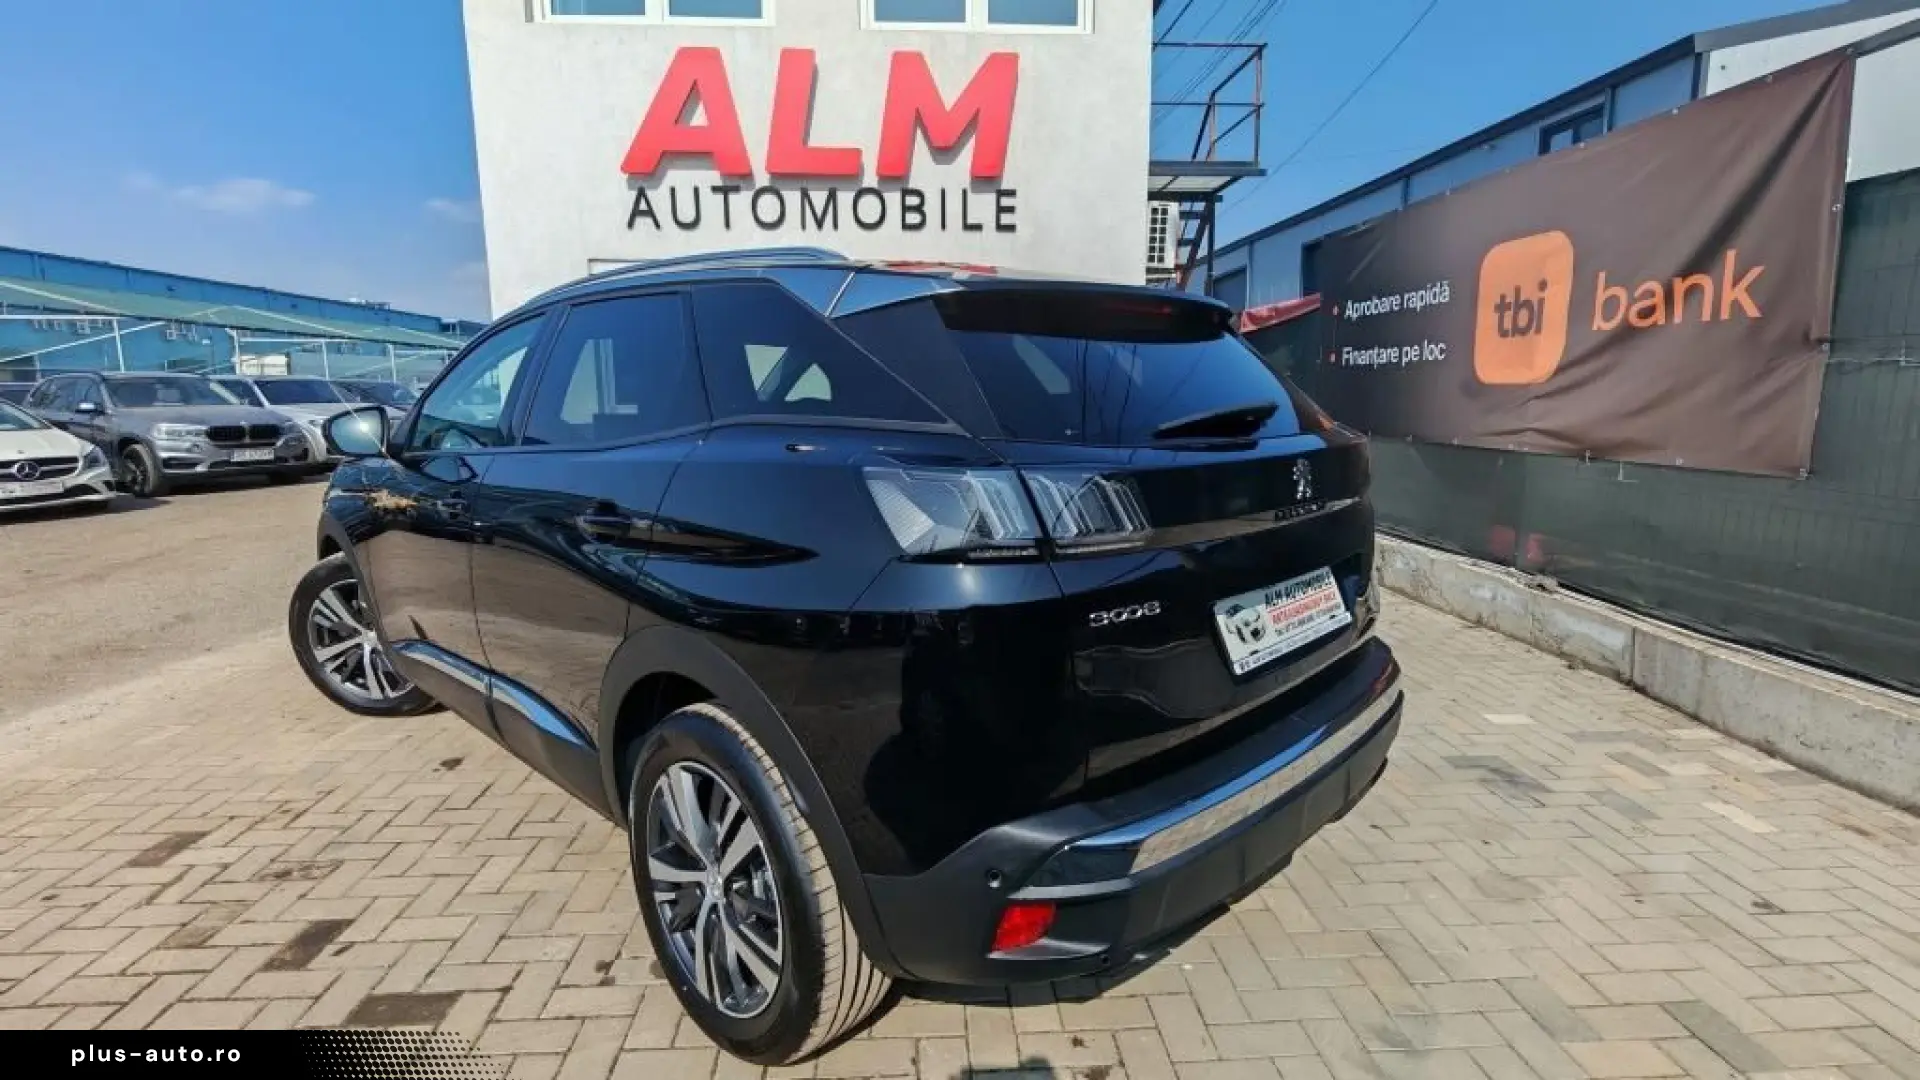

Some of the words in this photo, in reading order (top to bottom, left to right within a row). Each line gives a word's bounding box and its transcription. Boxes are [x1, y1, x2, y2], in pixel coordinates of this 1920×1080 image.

[621, 46, 1020, 178] ALM
[627, 185, 1018, 232] AUTOMOBILE
[1343, 294, 1401, 321] Aprobare
[1403, 281, 1450, 312] rapidă
[1493, 278, 1548, 339] tbi
[1591, 249, 1765, 331] bank
[1402, 345, 1421, 367] pe
[1422, 339, 1446, 361] loc
[1089, 601, 1161, 627] 3008
